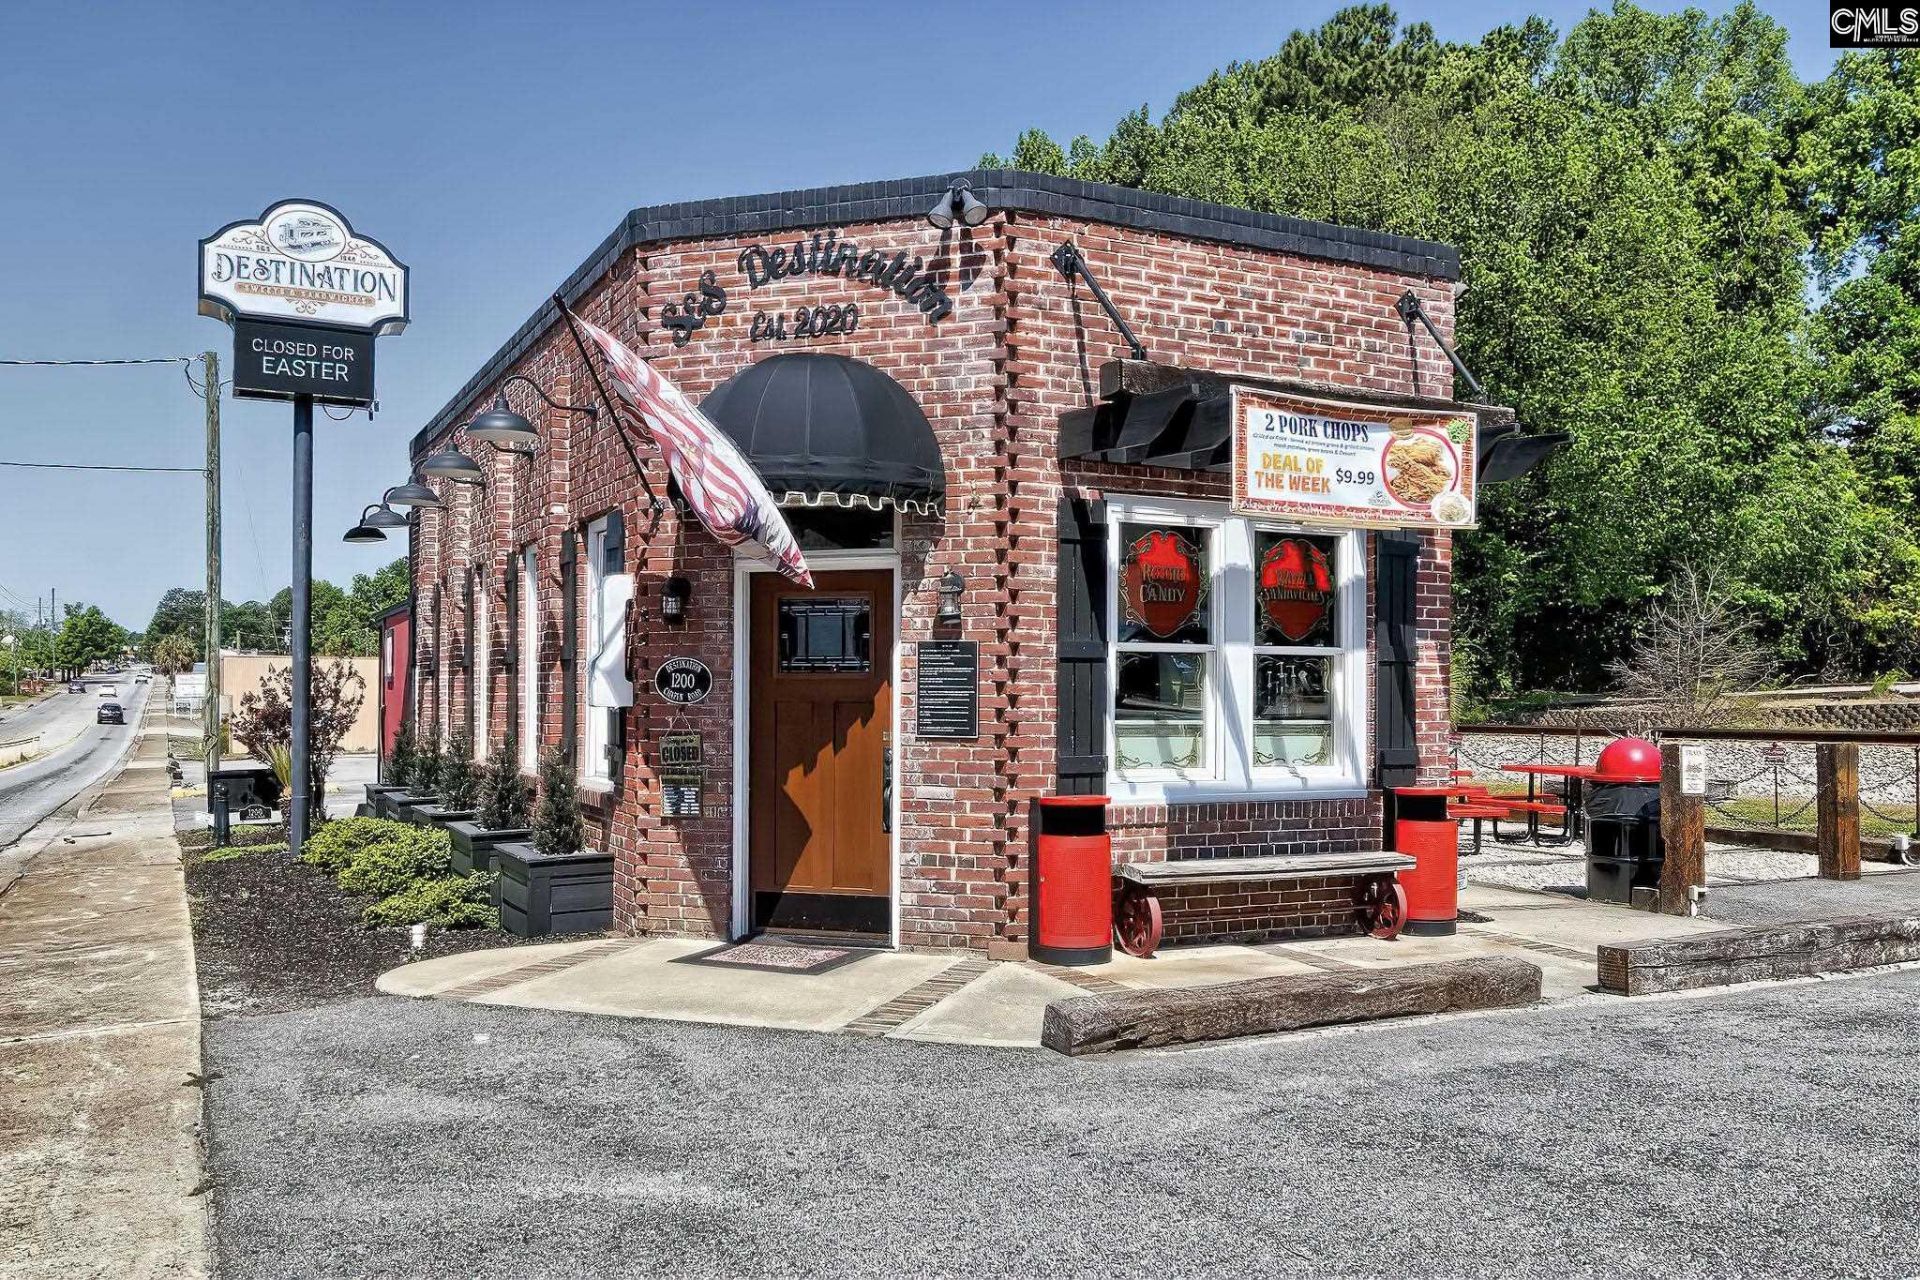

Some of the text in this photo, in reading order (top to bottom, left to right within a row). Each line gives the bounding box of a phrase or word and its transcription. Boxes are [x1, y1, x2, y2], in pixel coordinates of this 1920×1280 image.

[211, 253, 397, 301] DESTINATION
[738, 230, 952, 327] Destination
[794, 303, 860, 340] 2020
[252, 338, 355, 361] CLOSED FOR
[262, 356, 349, 382] EASTER
[1265, 413, 1369, 443] 2 PORK CHOPS
[1262, 452, 1323, 474] DEAL OF
[1255, 471, 1331, 494] THE WEEK
[1336, 467, 1375, 485] $9.99
[1140, 583, 1186, 602] CANDY
[665, 660, 702, 673] DESTINATION
[671, 672, 695, 688] 1200
[661, 746, 700, 762] CLOSED
